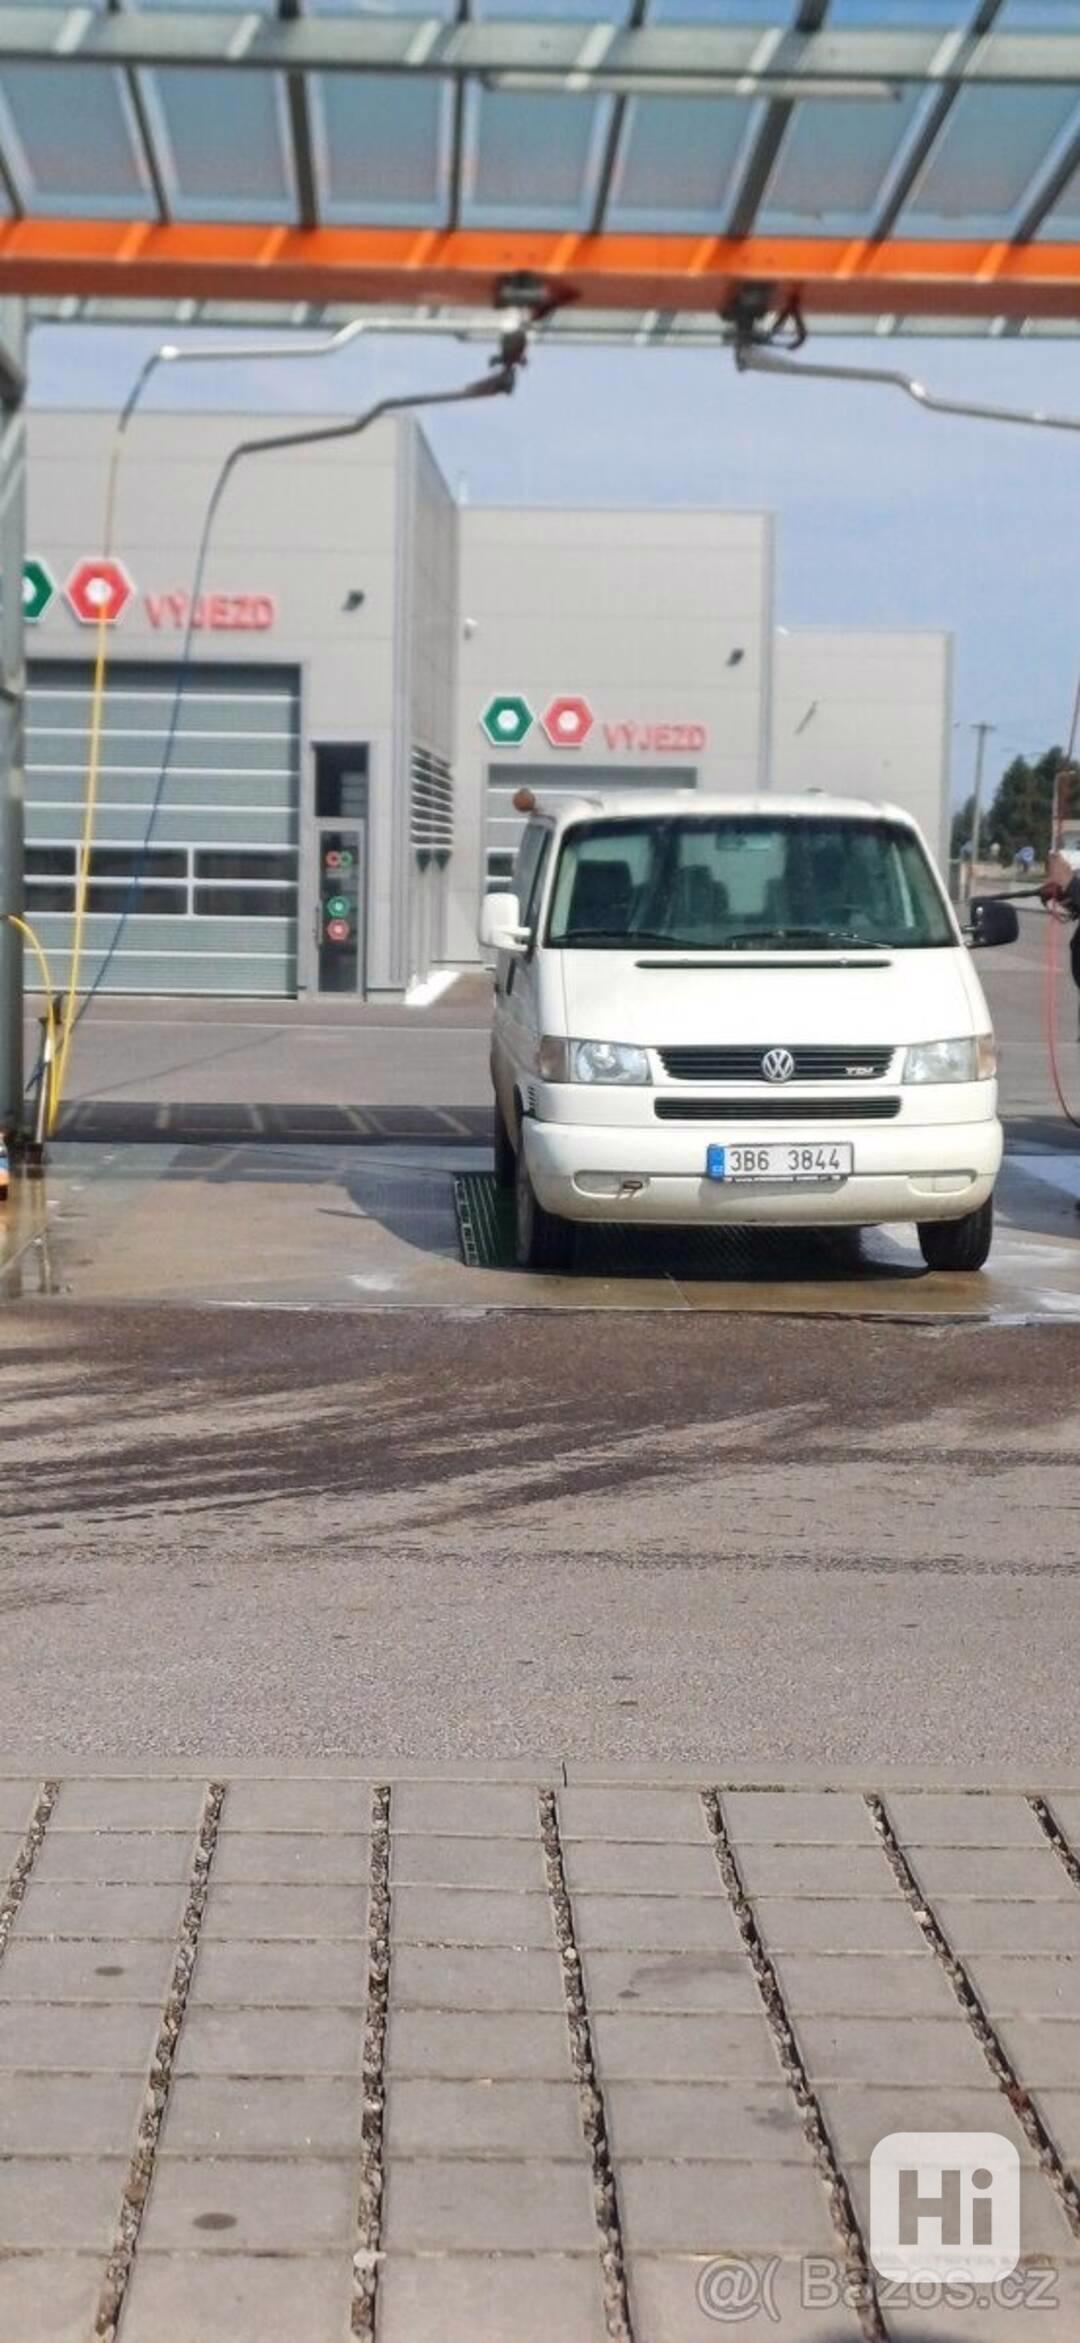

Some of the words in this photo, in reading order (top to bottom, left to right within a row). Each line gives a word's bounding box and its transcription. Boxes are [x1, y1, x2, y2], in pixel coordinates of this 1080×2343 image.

[142, 588, 275, 630] VÝJEZD
[601, 719, 706, 751] VÝJEZD
[730, 1150, 769, 1172] 3B6
[787, 1148, 840, 1171] 3844
